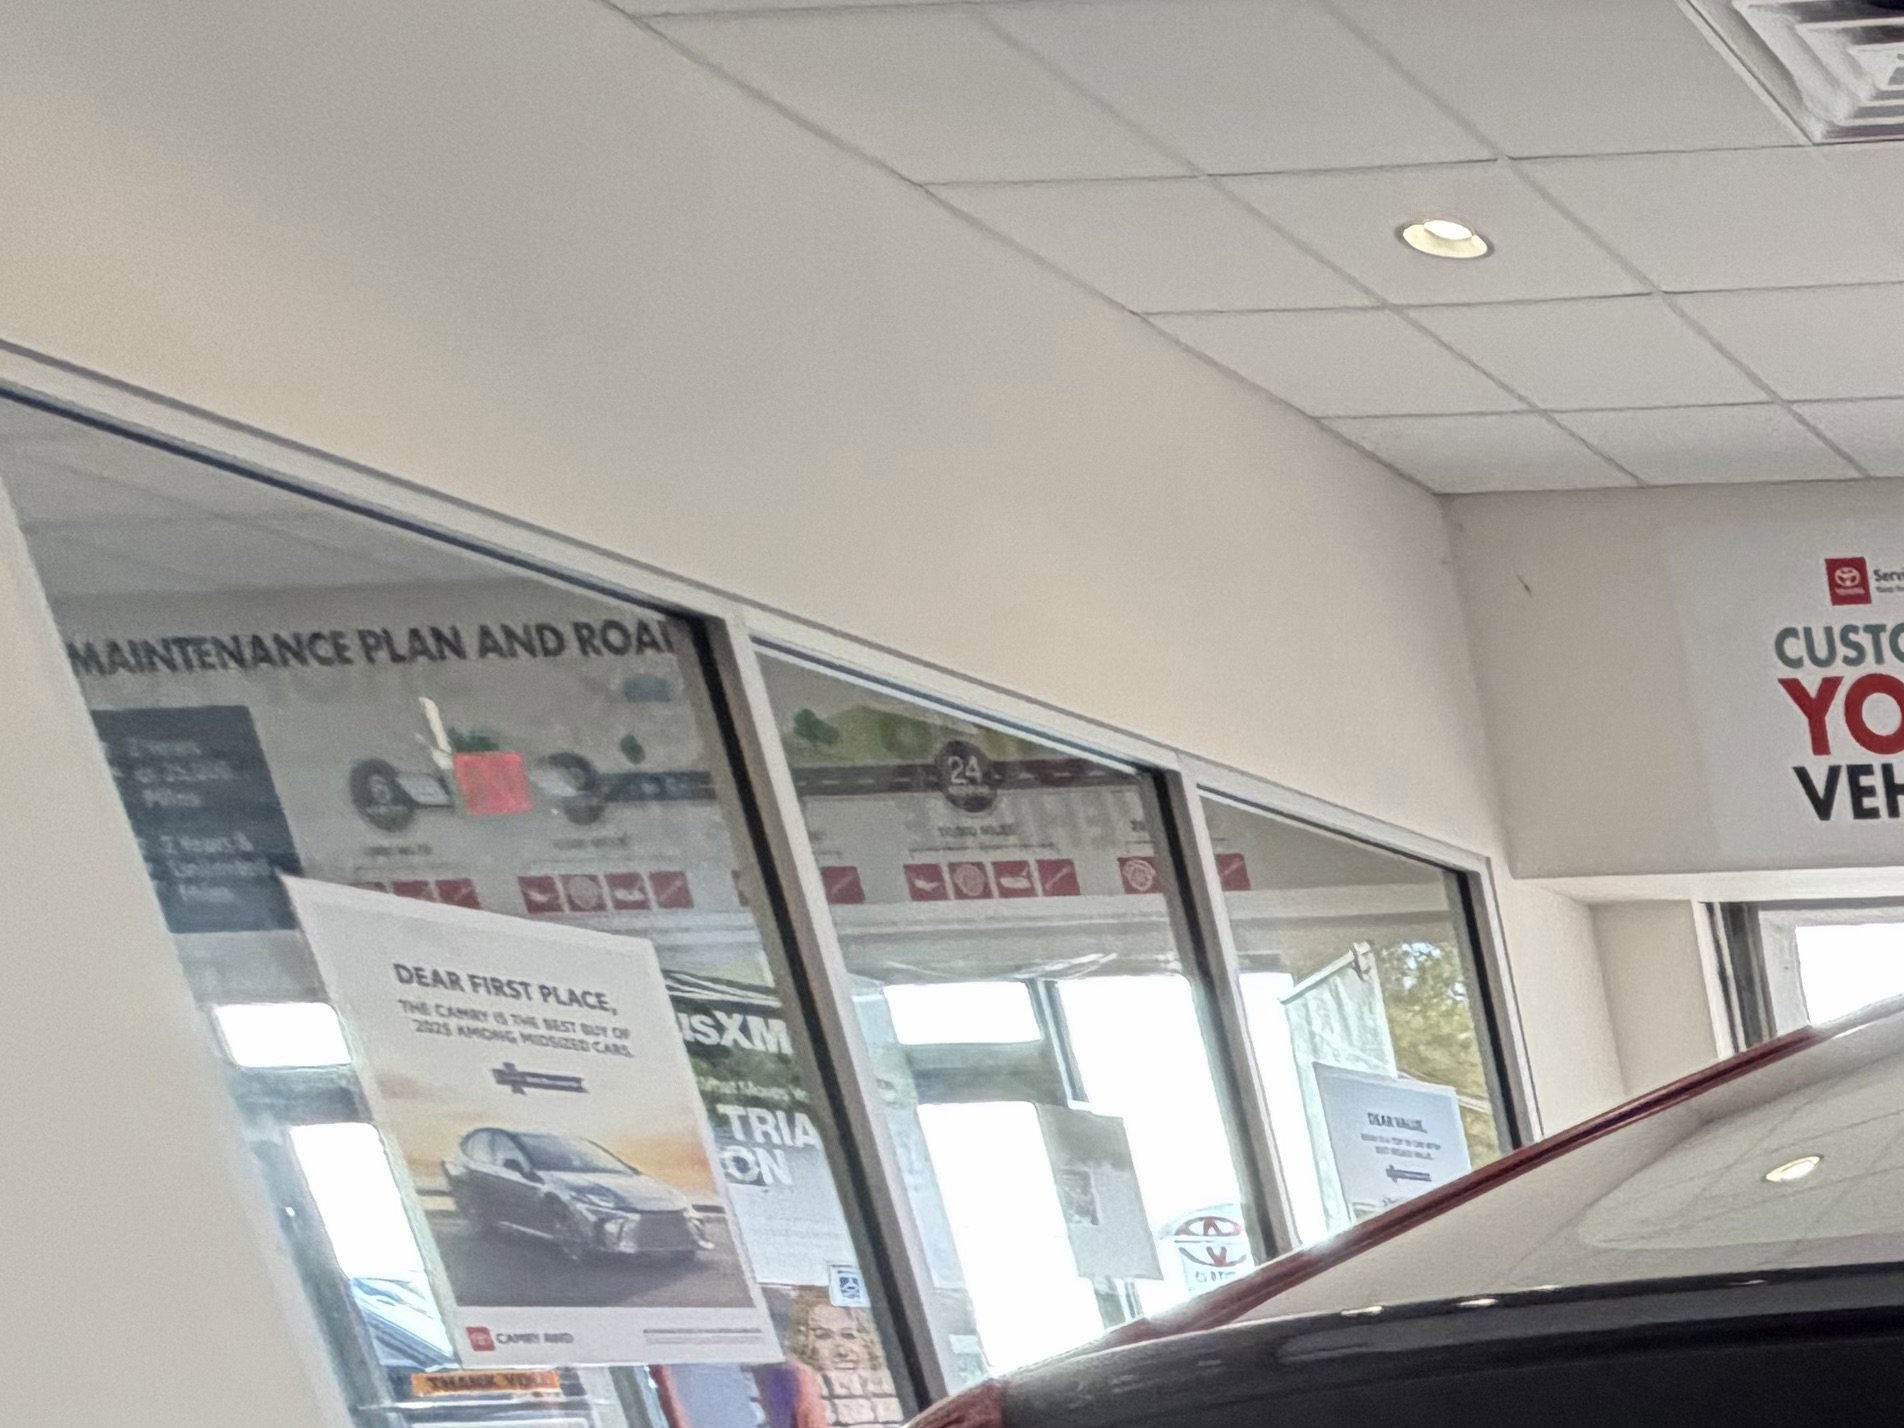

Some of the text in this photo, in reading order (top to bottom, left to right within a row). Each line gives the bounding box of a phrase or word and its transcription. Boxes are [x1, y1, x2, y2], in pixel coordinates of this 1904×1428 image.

[65, 630, 354, 676] MAINTENANCE
[357, 625, 467, 664] PLAN
[478, 622, 566, 659] AND
[947, 755, 984, 785] 24
[393, 963, 618, 1016] DEAR FIRST PLACE,
[721, 1145, 794, 1186] ON
